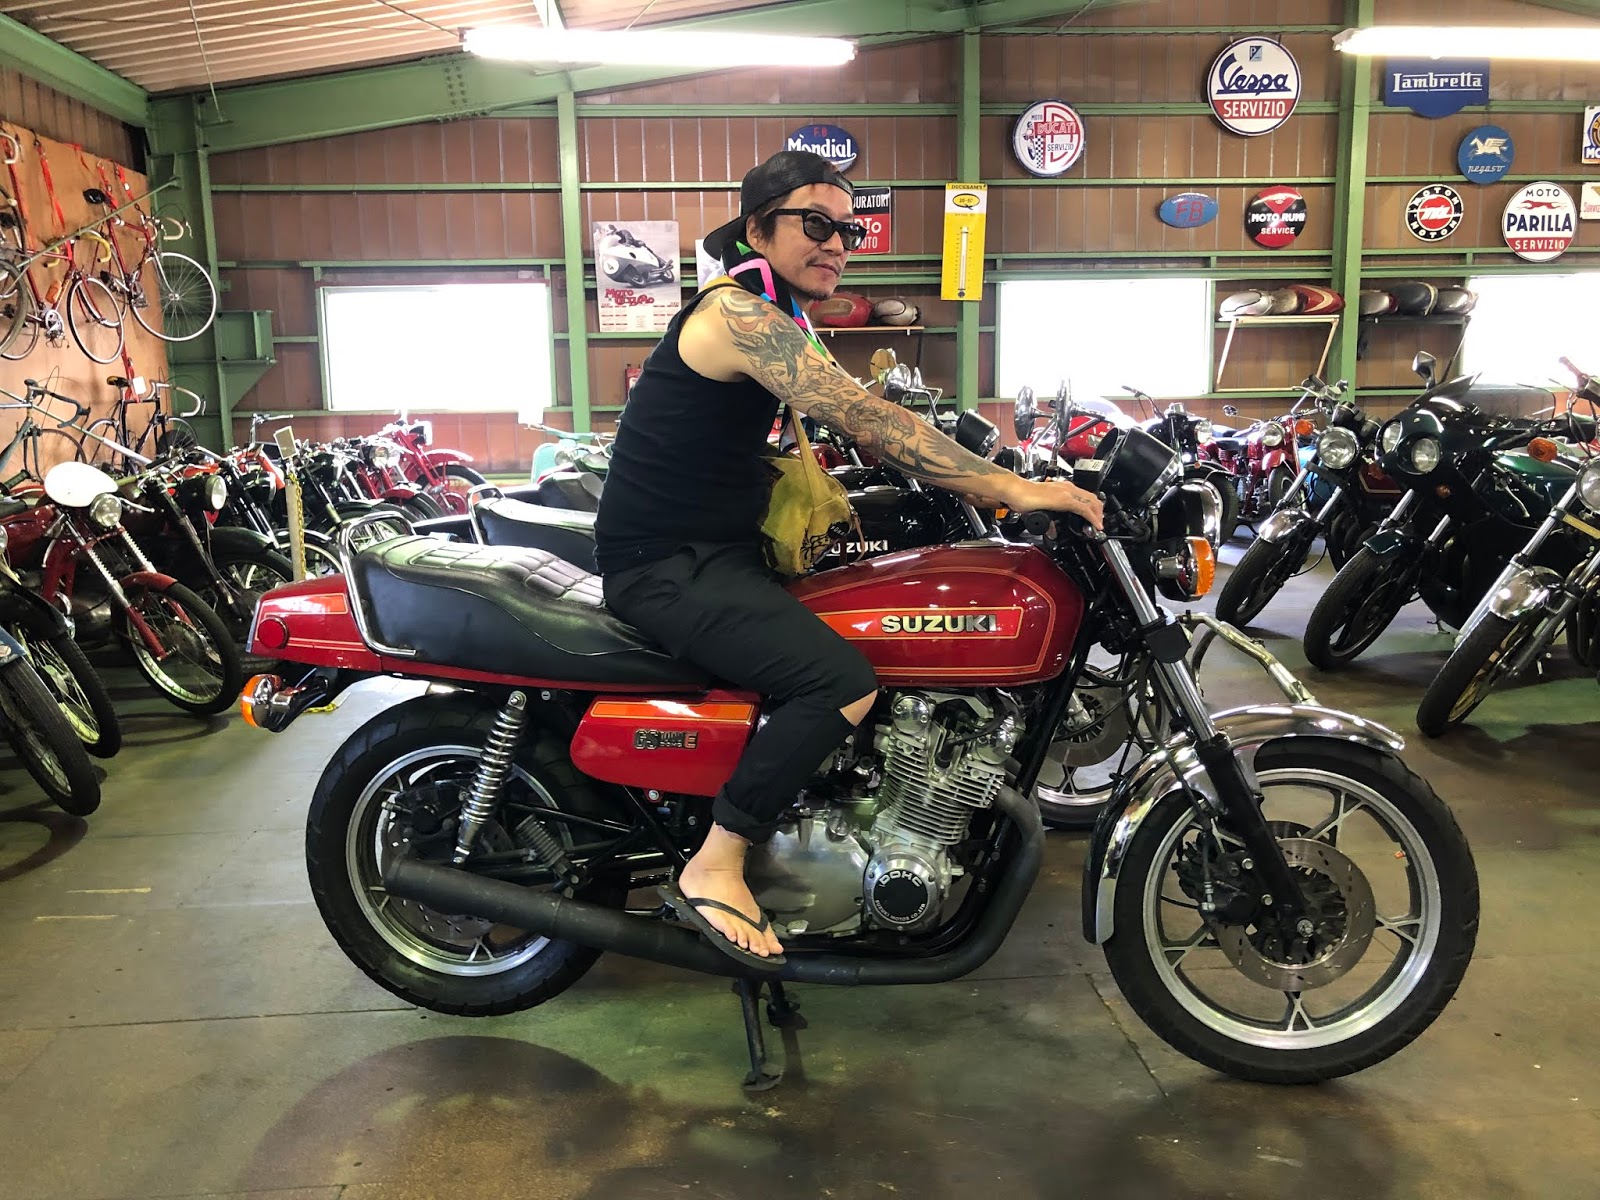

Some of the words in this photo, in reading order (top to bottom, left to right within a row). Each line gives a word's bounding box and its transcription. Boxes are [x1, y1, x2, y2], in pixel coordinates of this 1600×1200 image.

[1216, 53, 1292, 96] Vespa
[1392, 72, 1483, 92] Lambretta
[1223, 101, 1285, 117] SERVIZIO
[1037, 122, 1076, 134] DUCATI
[787, 134, 857, 161] Mondial
[853, 193, 888, 209] URATORI
[1526, 189, 1560, 197] MOTO
[1251, 213, 1281, 223] MOTO
[1506, 213, 1573, 232] PARILLA
[1261, 227, 1295, 235] SERVICE
[1515, 239, 1565, 250] SERVIZIO
[831, 540, 888, 554] UZUKI
[881, 615, 997, 633] SUZUKI
[879, 870, 922, 887] DOHC
